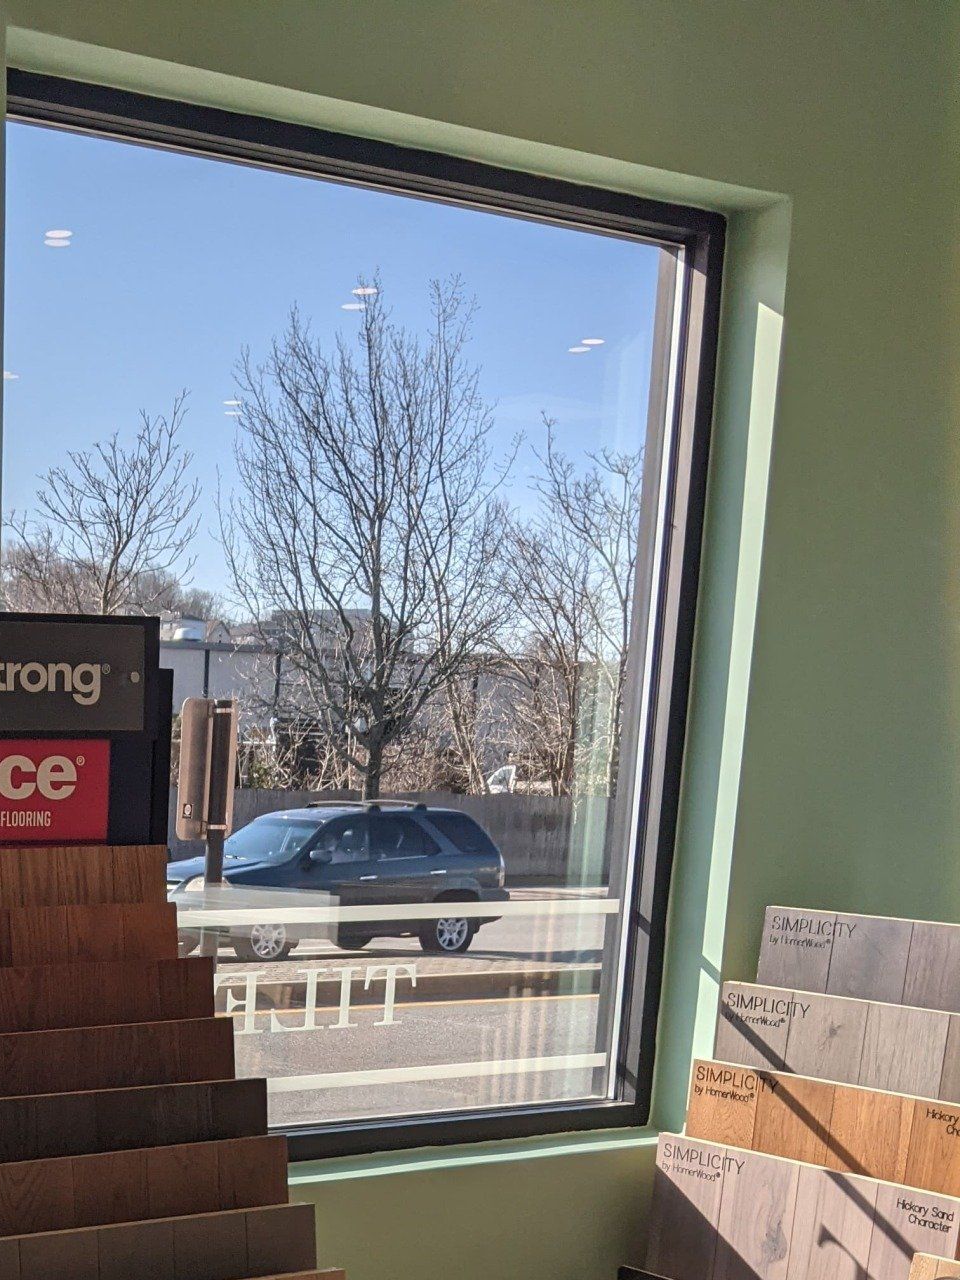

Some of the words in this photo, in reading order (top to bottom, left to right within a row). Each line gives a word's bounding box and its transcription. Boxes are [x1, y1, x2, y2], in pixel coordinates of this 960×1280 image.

[0, 811, 51, 827] FLOORING
[771, 915, 857, 938] SIMPLICITY
[727, 992, 811, 1019] SIMPLICITY
[696, 1065, 779, 1094] SIMPLICITY
[926, 1108, 960, 1126] Hickory
[663, 1143, 746, 1175] SIMPLICITY
[896, 1198, 929, 1217] Hickory
[932, 1207, 955, 1222] Sand
[908, 1213, 952, 1234] Character
